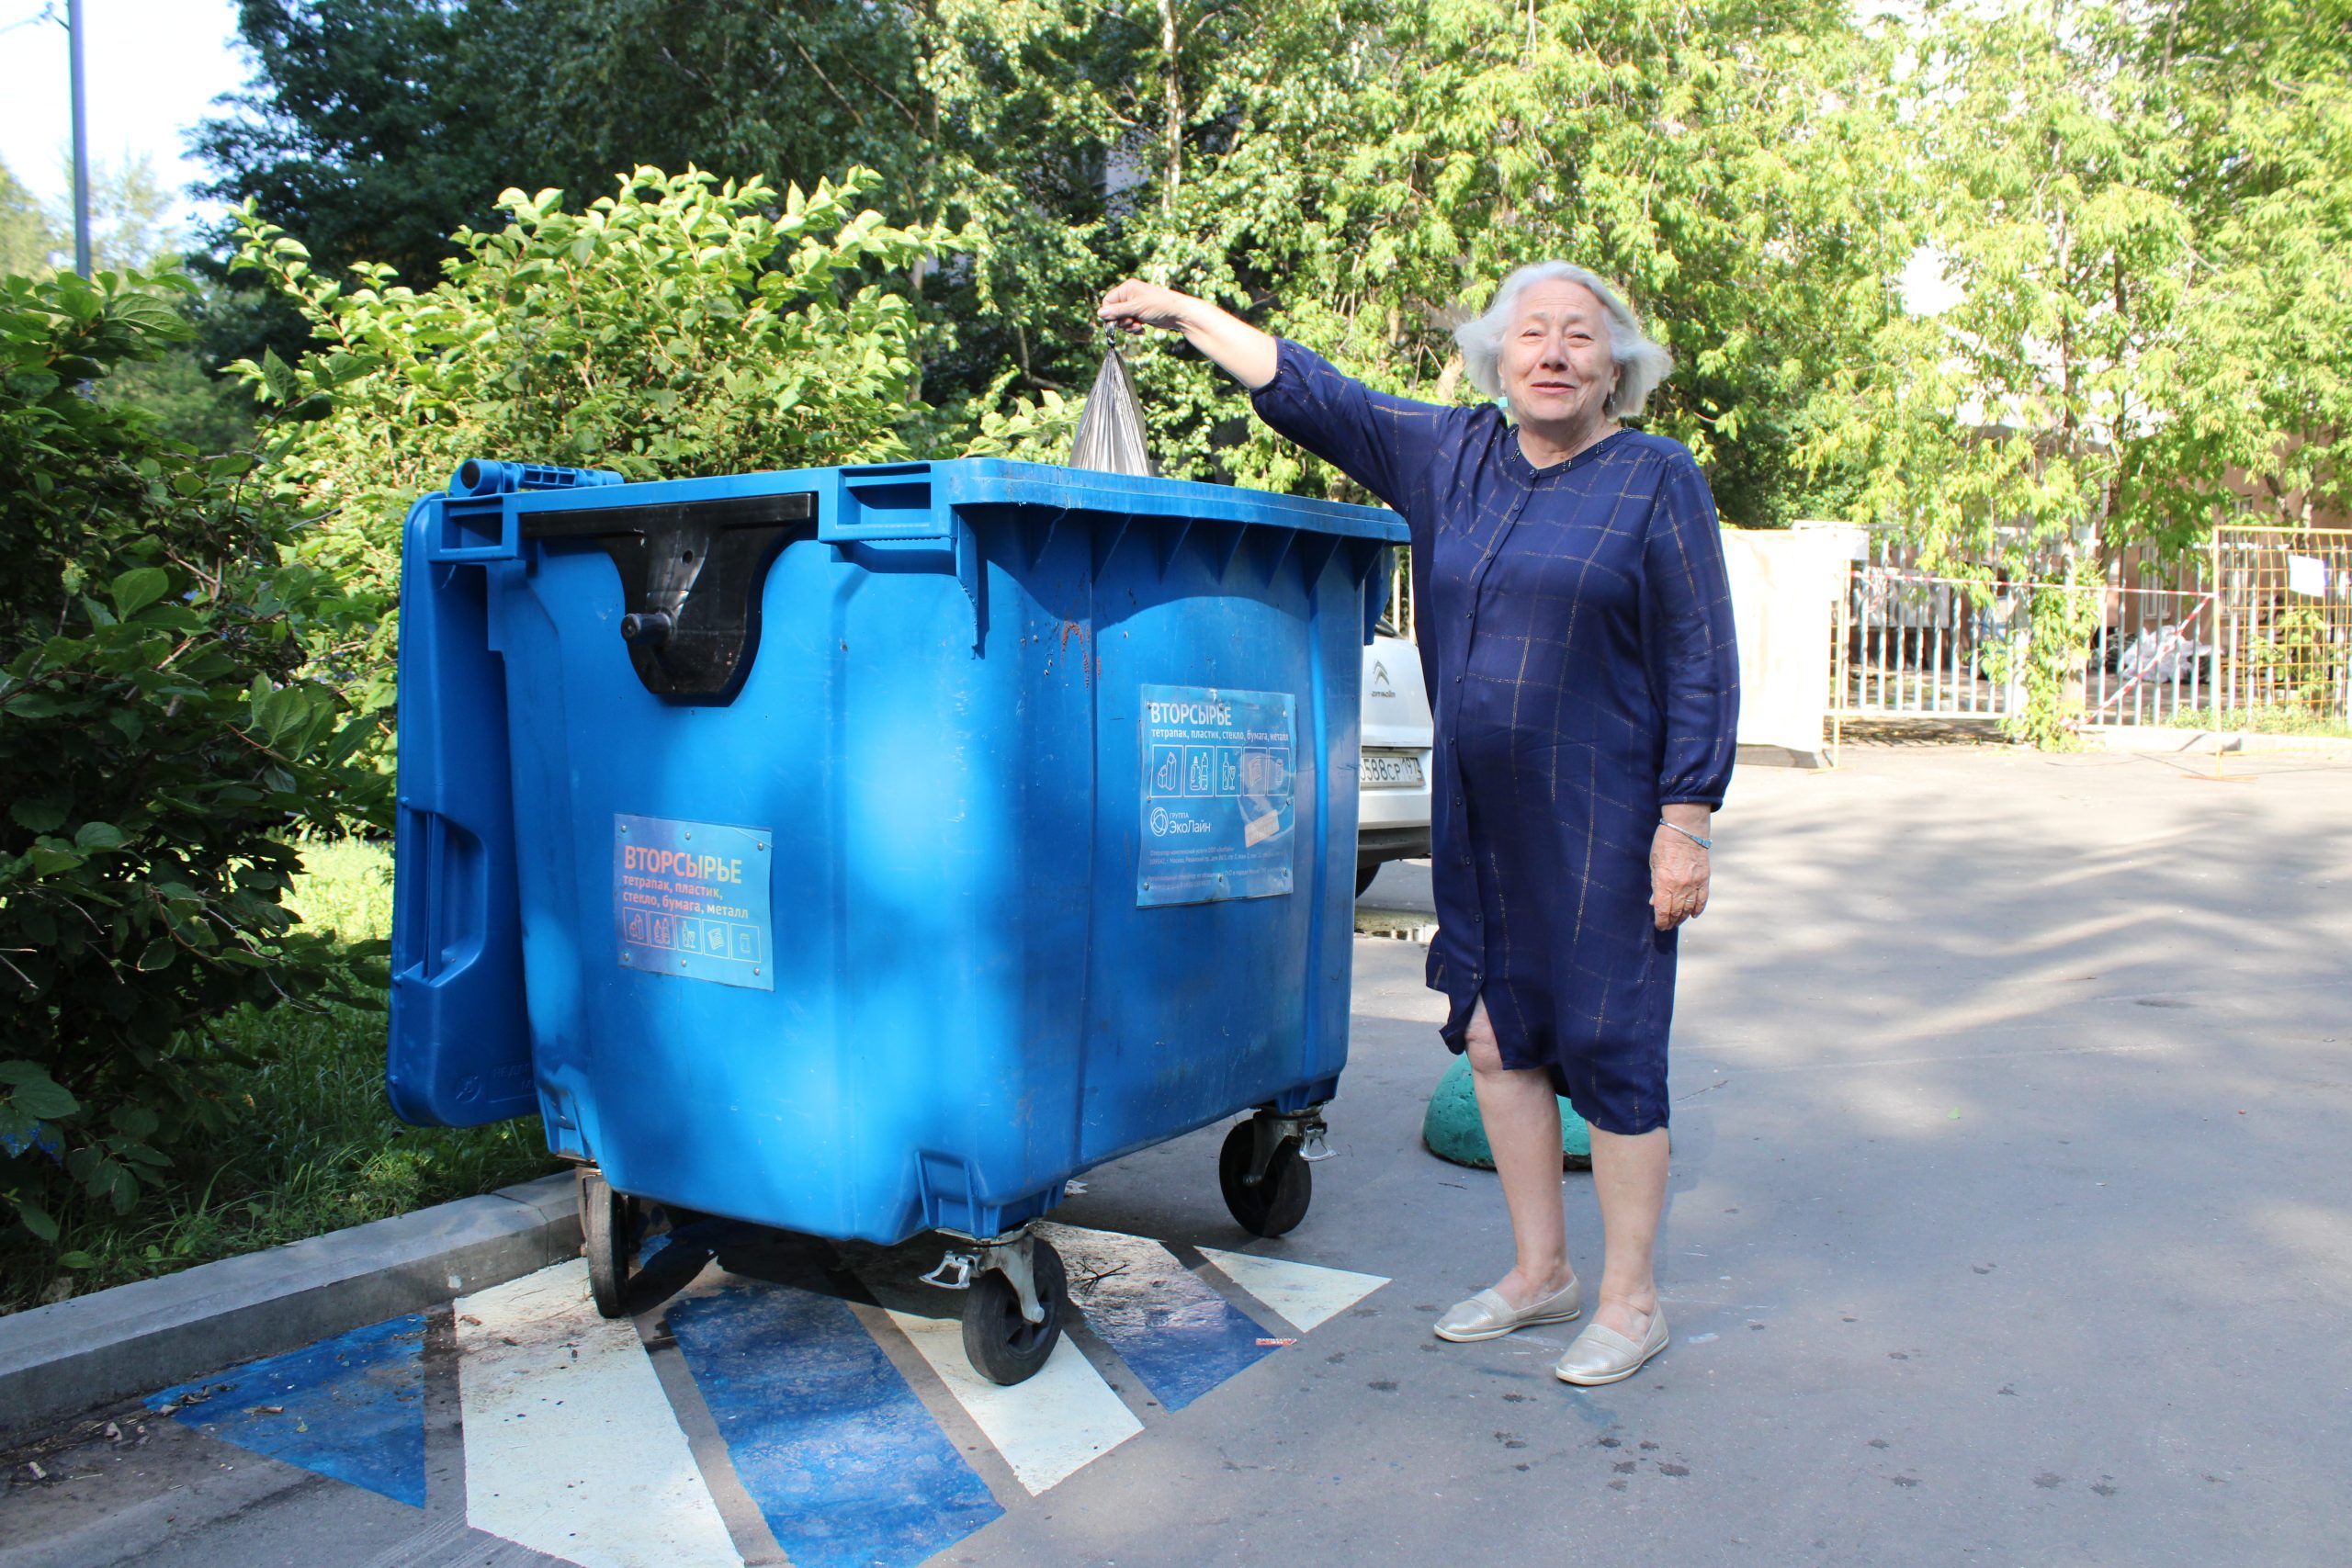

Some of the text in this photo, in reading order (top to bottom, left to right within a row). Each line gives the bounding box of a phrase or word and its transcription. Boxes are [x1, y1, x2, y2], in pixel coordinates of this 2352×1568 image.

[1151, 702, 1232, 726] ВТОРСЫРЬЕ
[1151, 728, 1189, 740] тетрапак,
[1191, 730, 1221, 740] пластик,
[1222, 731, 1246, 741] стекло,
[1247, 730, 1270, 742] бумага,
[1170, 819, 1211, 834] ЭкоЛайн
[625, 844, 742, 884] ВТОРСЫРЬЕ
[623, 874, 723, 900] тетрапак, пластик,
[623, 891, 749, 919] стекло, бумага, металл
